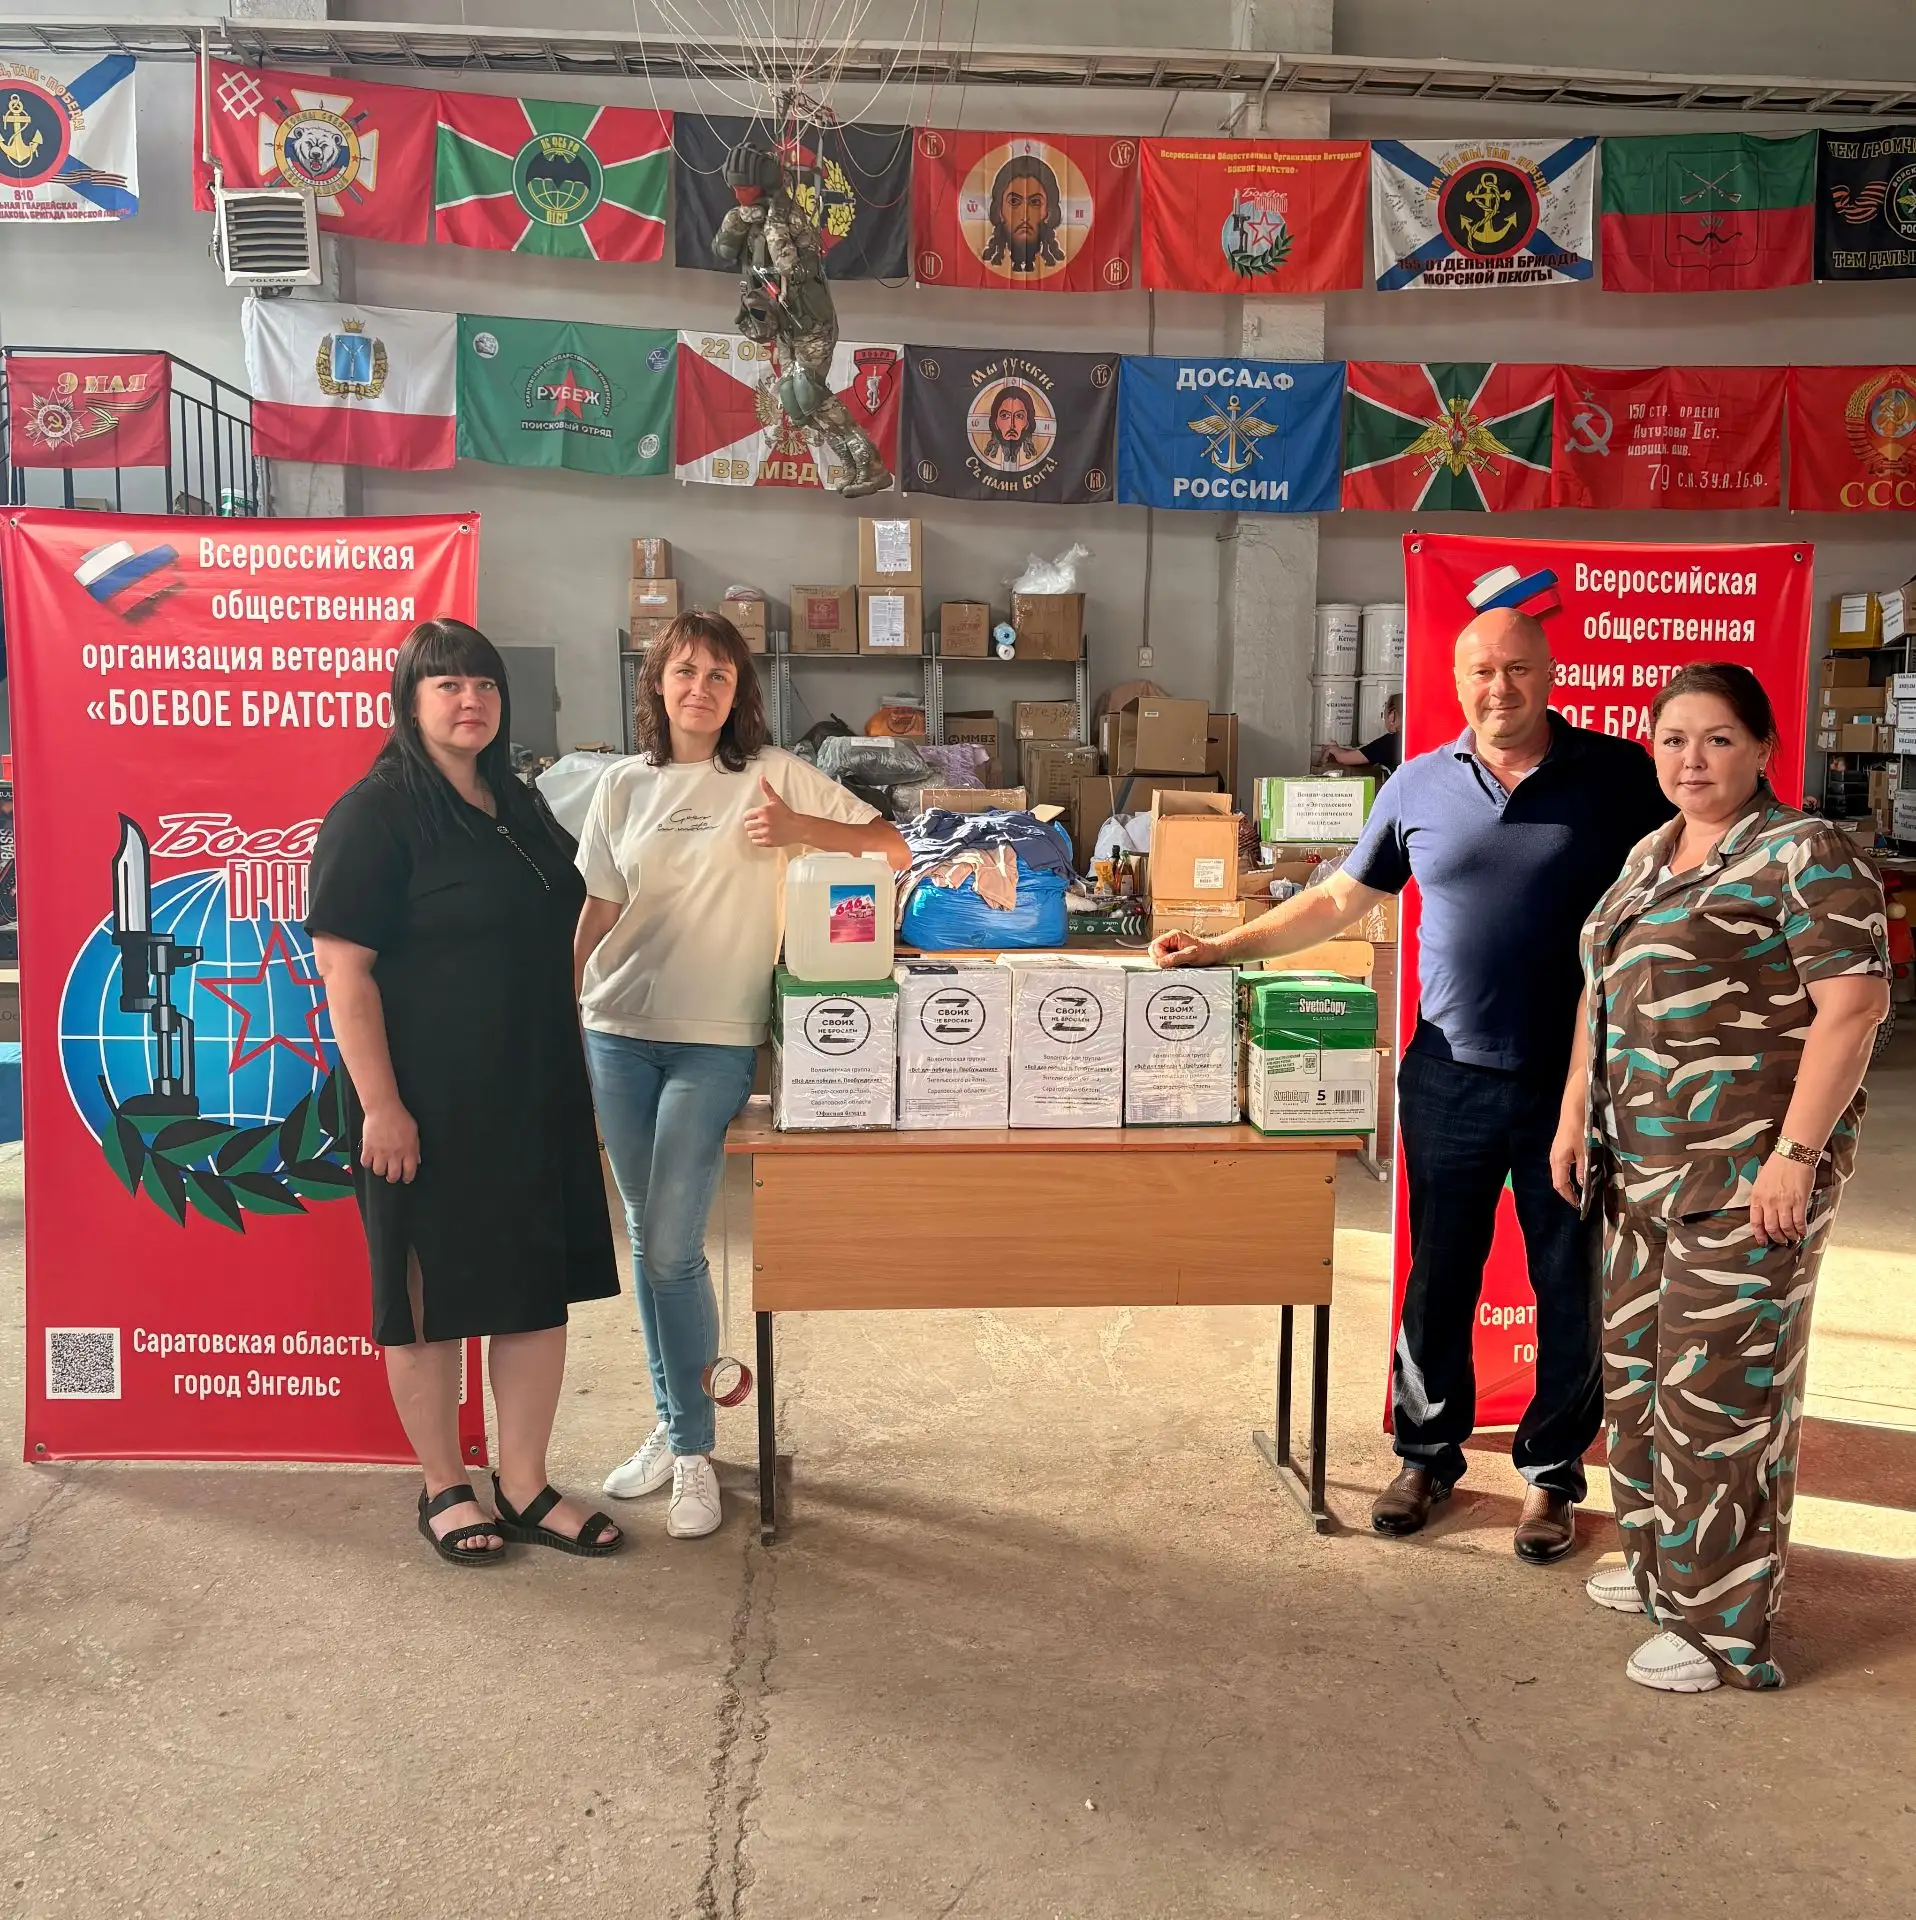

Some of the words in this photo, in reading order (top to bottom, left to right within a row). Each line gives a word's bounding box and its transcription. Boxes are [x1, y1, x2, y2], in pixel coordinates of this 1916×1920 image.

[11, 63, 39, 81] ТАМ
[1161, 150, 1216, 160] Всероссийская
[1217, 152, 1272, 161] Общественная
[1273, 152, 1322, 162] Организация
[1323, 151, 1362, 161] Ветеранов
[1486, 146, 1511, 160] ТАМ
[1827, 141, 1860, 159] ЧЕМ
[1862, 137, 1916, 158] ГРОМЧ
[14, 190, 34, 200] 810
[1241, 187, 1288, 200] Боевое
[1426, 257, 1514, 272] ОТДЕЛЬНАЯ
[1517, 252, 1579, 268] БРИГАДА
[1833, 251, 1866, 268] ТЕМ
[1424, 270, 1495, 286] МОРСКОЙ
[701, 337, 731, 360] 22
[57, 372, 78, 395] 9
[83, 374, 148, 394] МАЯ
[1176, 367, 1294, 391] ДОСААФ
[537, 386, 600, 406] РУБЕЖ
[1629, 404, 1646, 419] 150
[1650, 406, 1671, 418] СТР.
[1680, 406, 1720, 419] ОРДЕНА
[521, 421, 579, 431] ПОИСКОВЫЙ
[581, 425, 613, 438] ОТРЯД
[712, 458, 749, 479] ВВ
[758, 461, 819, 486] МВД
[827, 465, 847, 484] Р
[1648, 464, 1670, 491] 79
[1173, 477, 1289, 501] РОССИИ
[199, 537, 415, 575] Всероссийская
[1575, 563, 1758, 599] Всероссийская
[212, 590, 415, 624] общественная
[1584, 613, 1755, 645] общественная
[83, 643, 263, 675] организация
[272, 645, 399, 676] ветерано
[1554, 664, 1624, 690] зация
[87, 688, 231, 727] «БОЕВОЕ
[242, 690, 394, 729] БРАТСТВО
[150, 812, 325, 858] Боев
[835, 896, 863, 916] 646
[1299, 998, 1346, 1016] SvetoCopy
[1317, 1089, 1326, 1101] 5
[1480, 1302, 1536, 1330] Сарат
[133, 1328, 276, 1357] Саратовская
[282, 1330, 380, 1360] область,
[1513, 1343, 1534, 1363] го
[174, 1371, 241, 1400] город
[247, 1370, 341, 1397] Энгельс
